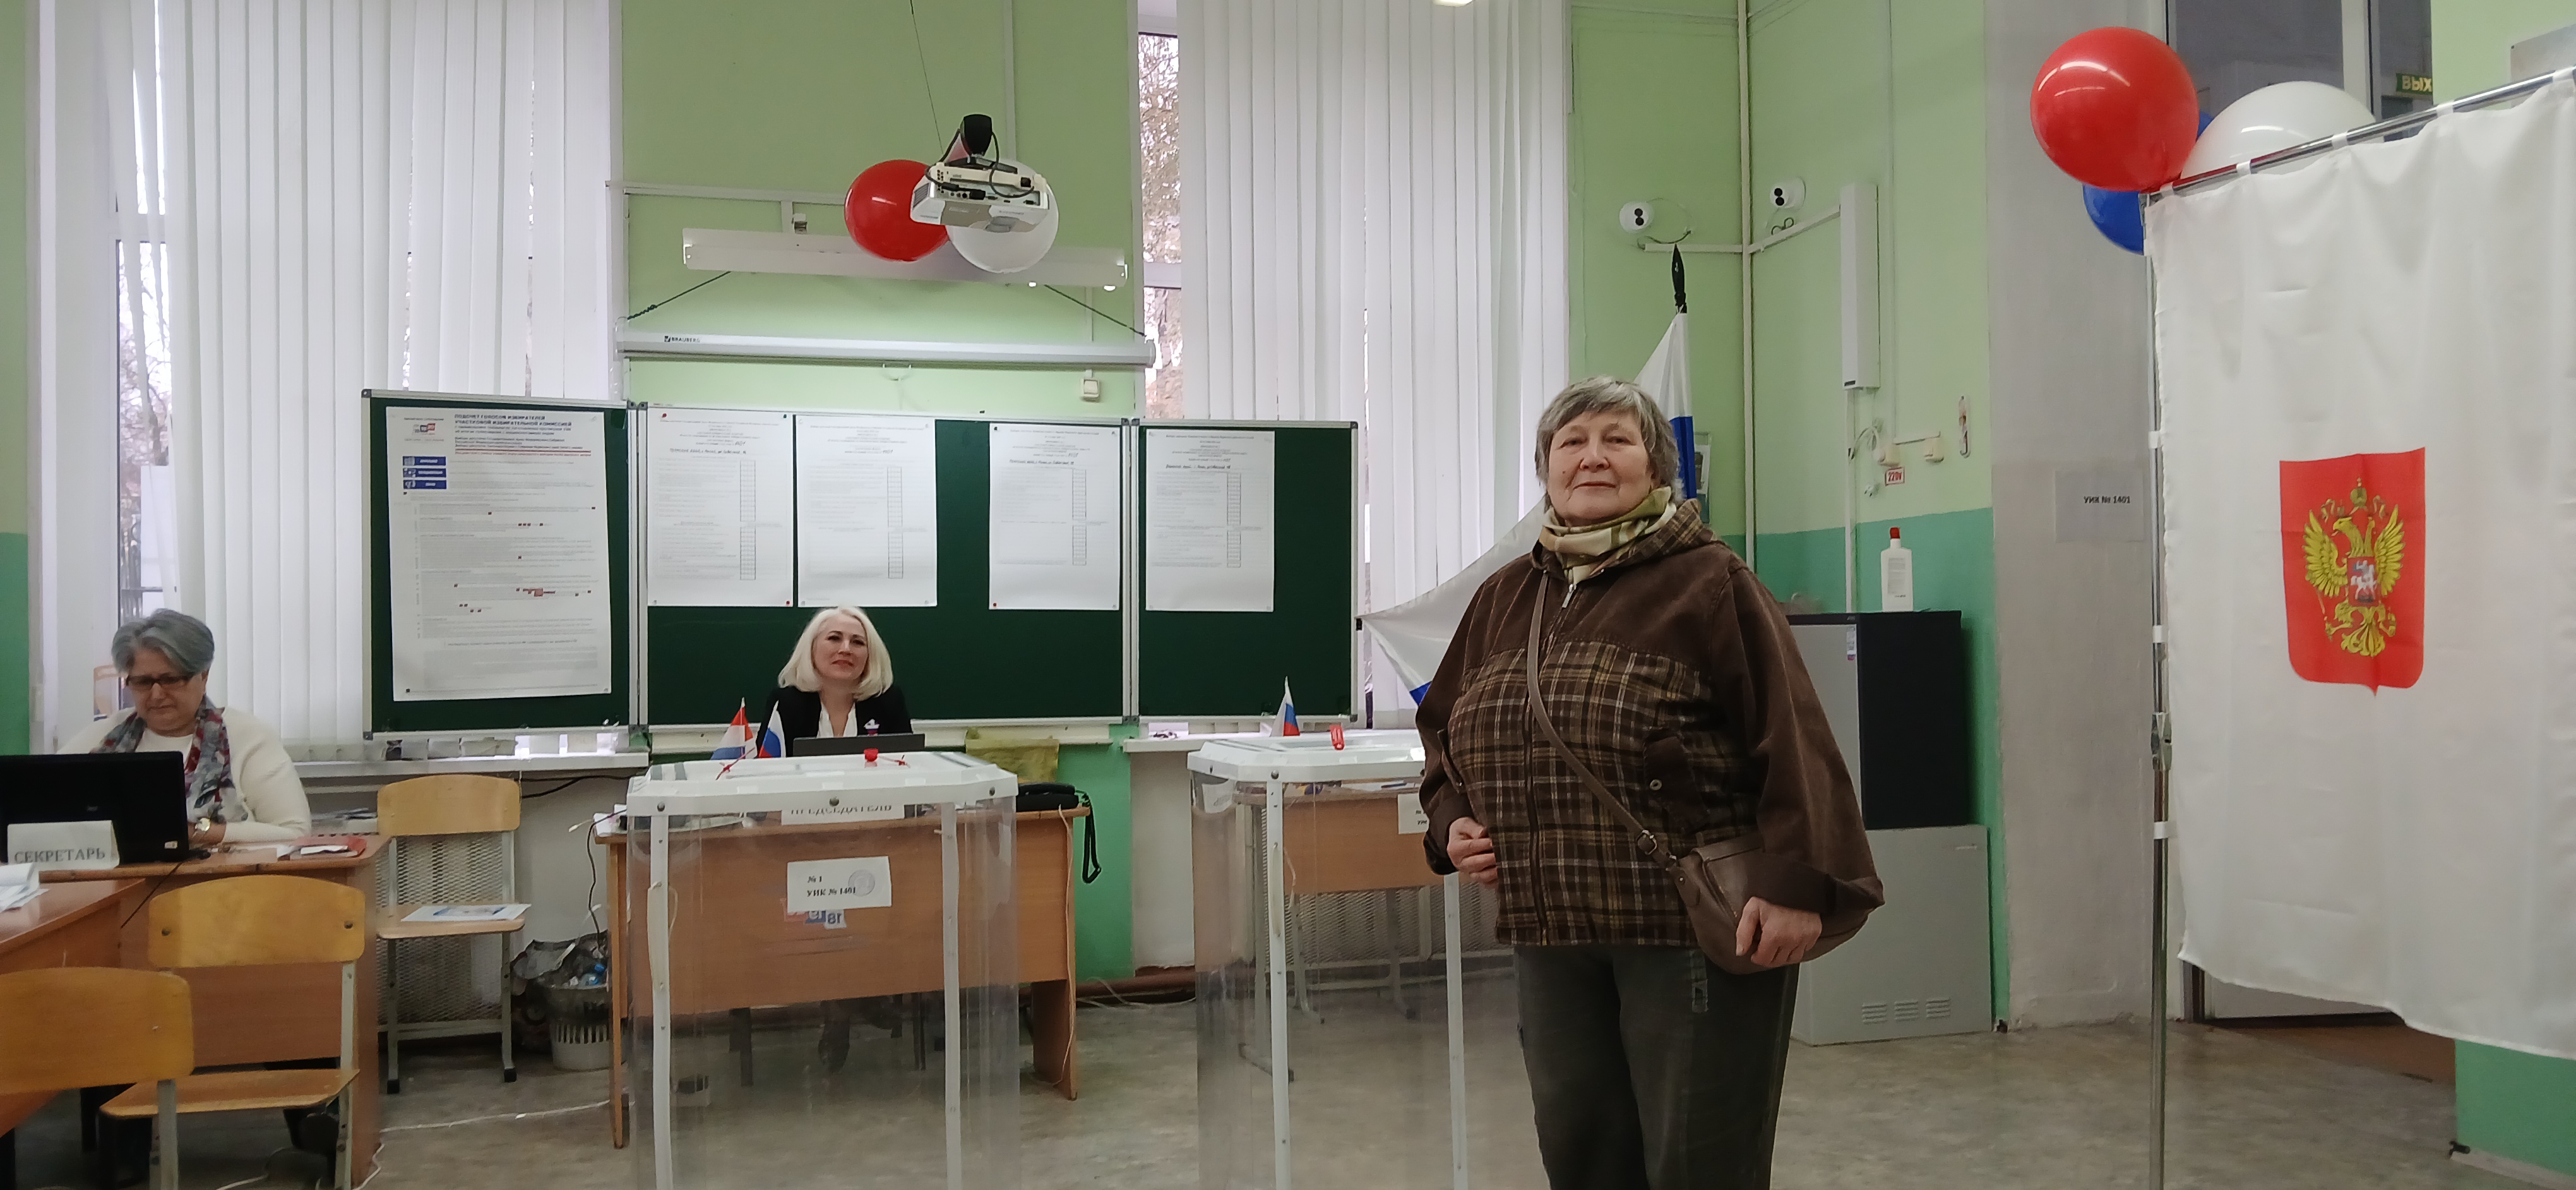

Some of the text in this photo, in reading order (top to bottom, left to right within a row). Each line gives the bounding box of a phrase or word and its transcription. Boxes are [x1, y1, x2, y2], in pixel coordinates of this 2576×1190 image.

[2113, 495, 2130, 504] 1401
[14, 847, 105, 864] СЕКРЕТАРЬ
[807, 888, 826, 897] УИК
[840, 887, 856, 895] 1401
